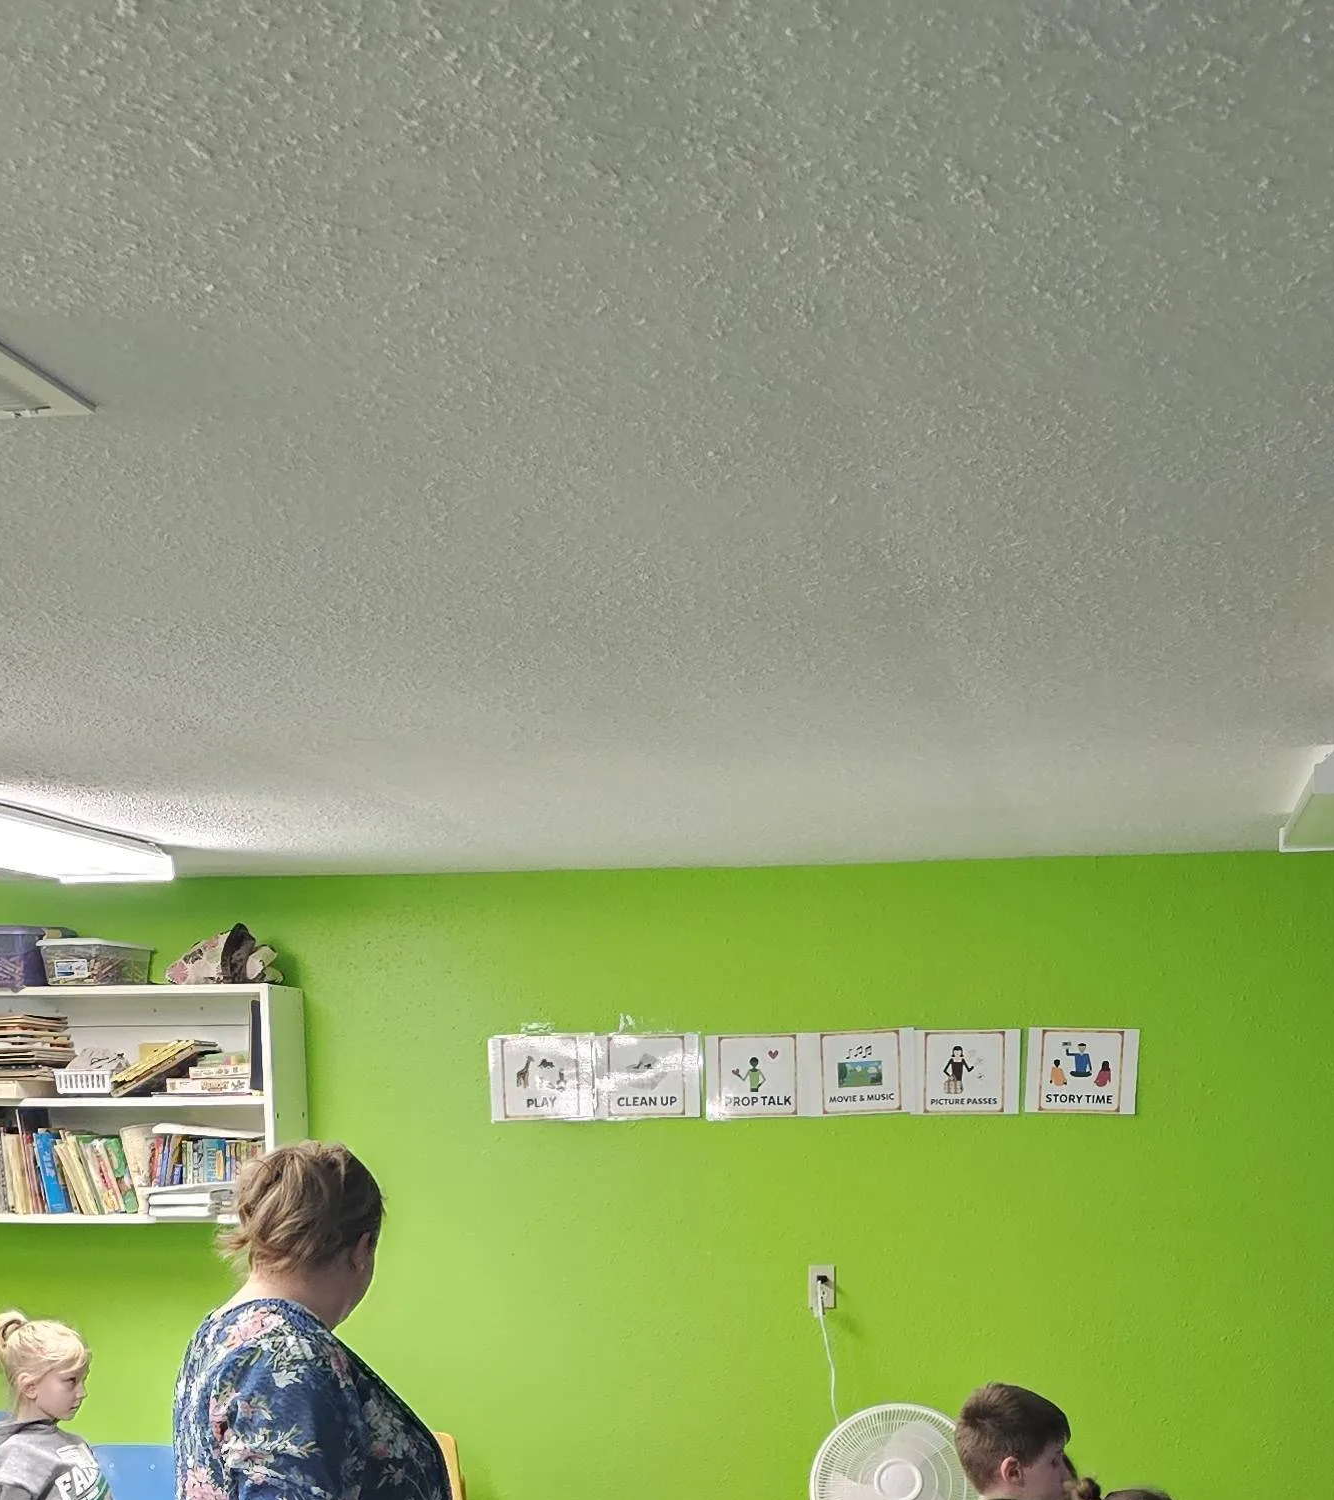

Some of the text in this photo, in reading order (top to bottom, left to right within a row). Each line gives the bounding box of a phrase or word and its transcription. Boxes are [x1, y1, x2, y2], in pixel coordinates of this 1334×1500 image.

[526, 1096, 557, 1108] PLAY
[617, 1095, 678, 1107] CLEAN UP
[725, 1095, 792, 1106] PROP TALK
[829, 1095, 858, 1104] MOVIE
[866, 1092, 895, 1101] MUSIC
[930, 1097, 998, 1105] PICTURE PASSES
[1045, 1093, 1113, 1104] STORY TIME
